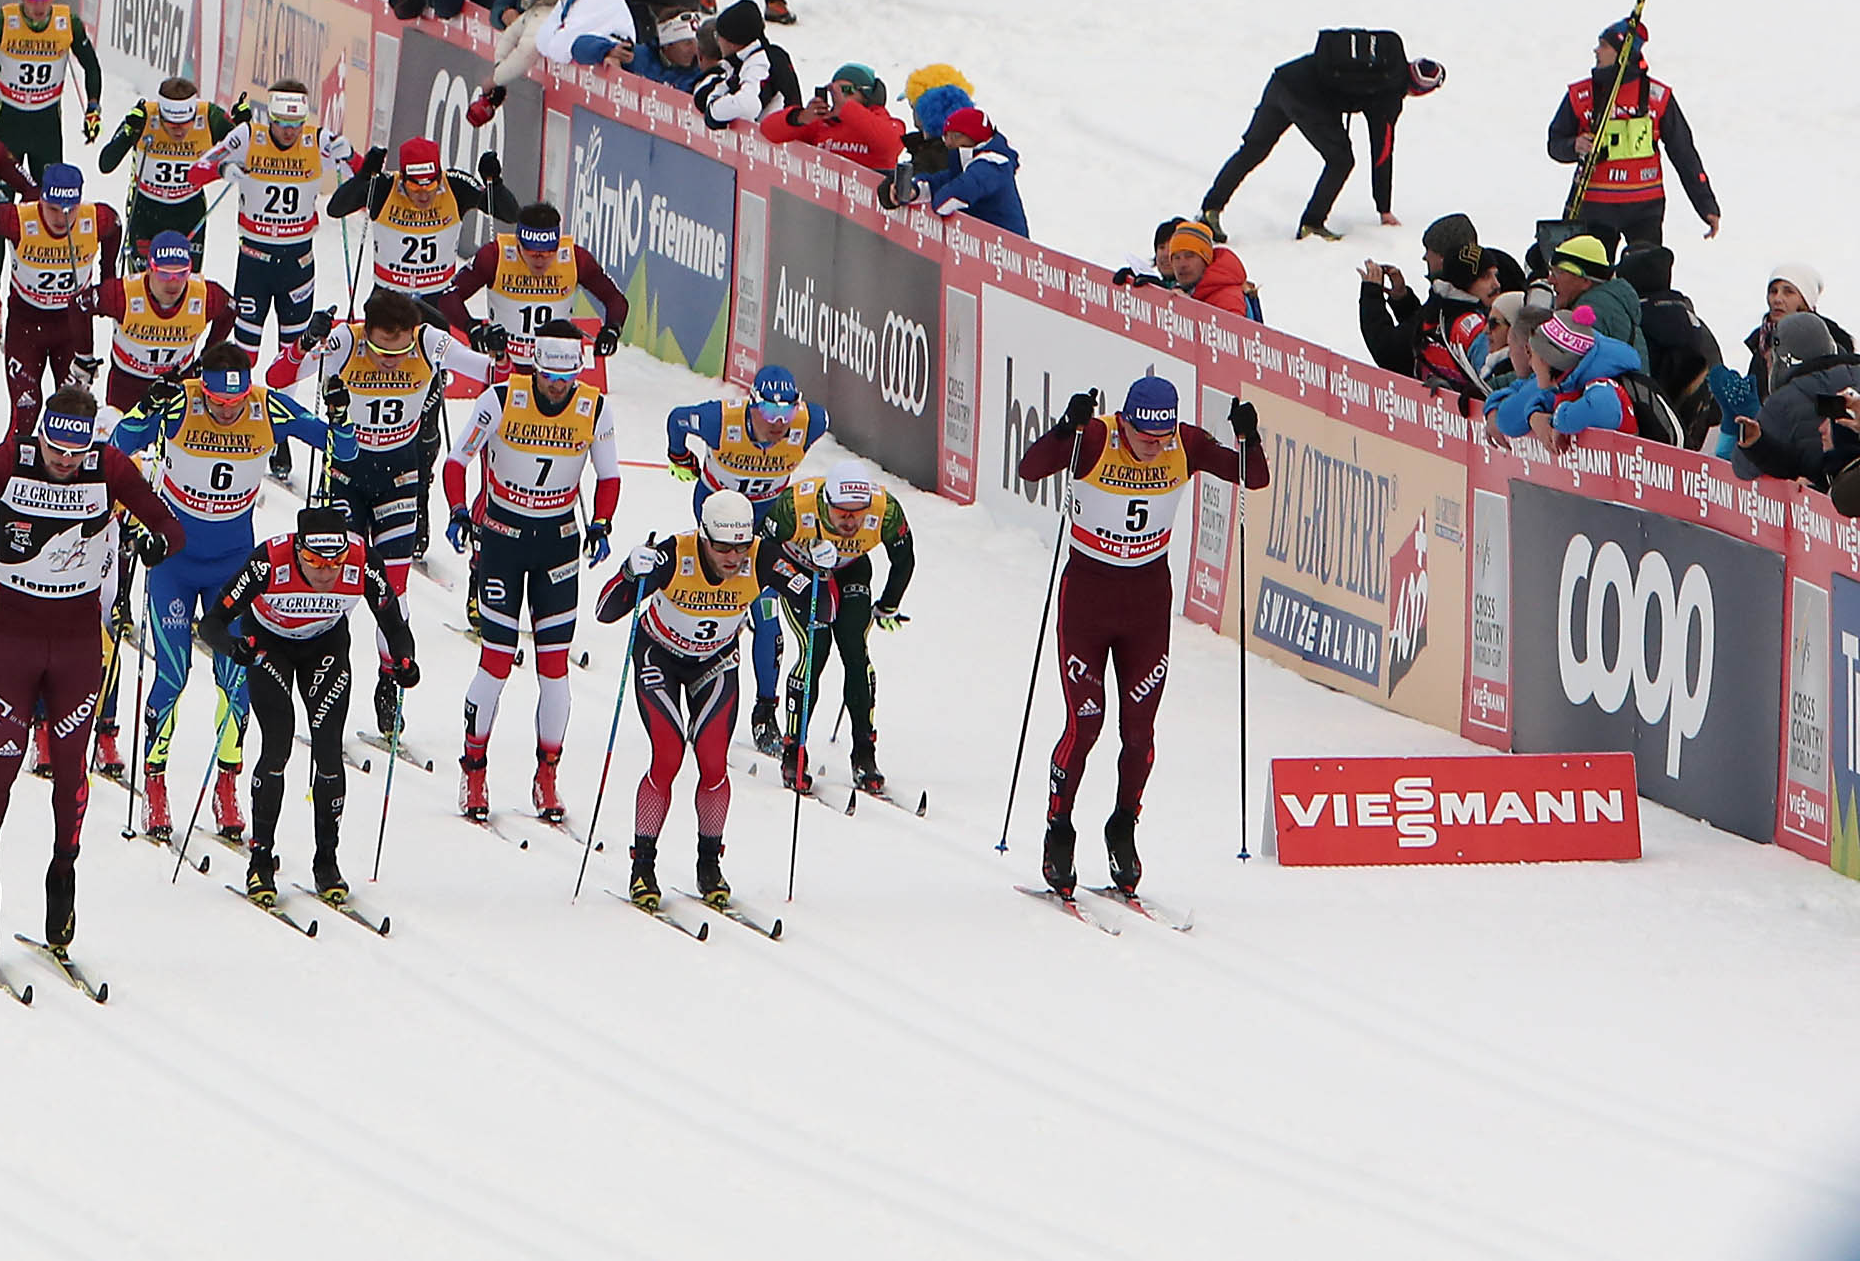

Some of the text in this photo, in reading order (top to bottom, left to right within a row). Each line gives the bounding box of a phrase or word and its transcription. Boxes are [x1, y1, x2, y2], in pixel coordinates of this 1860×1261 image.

[19, 63, 52, 84] 39
[155, 162, 188, 183] 35
[805, 155, 840, 199] VIESSMANN
[1608, 168, 1627, 182] FIN
[264, 185, 299, 214] 29
[841, 170, 874, 214] VIESSMANN
[255, 224, 304, 235] VIESSMANN
[521, 229, 557, 243] LUKOIL
[648, 194, 727, 281] fiemme
[946, 219, 980, 265] VIESSMANN
[401, 236, 438, 264] 25
[985, 236, 1022, 282] VIESSMANN
[38, 271, 76, 289] 23
[392, 273, 445, 287] VIESSMANN
[1025, 251, 1066, 299] VIESSMANN
[1068, 268, 1108, 314] VIESSMANN
[519, 305, 552, 333] 19
[773, 265, 815, 347] Audi
[817, 299, 876, 383] quattro
[1112, 284, 1151, 331] VIESSMANN
[1155, 299, 1195, 348] VIESSMANN
[1198, 314, 1238, 363] VIESSMANN
[1243, 331, 1283, 380] VIESSMANN
[1286, 346, 1327, 397] VIESSMANN
[1330, 364, 1370, 415] VIESSMANN
[1374, 381, 1418, 431] VIESSMANN
[48, 416, 92, 434] LUKOIL
[365, 398, 405, 425] 13
[1135, 407, 1177, 421] LUKOIL
[1423, 397, 1468, 448] VIESSMANN
[186, 430, 204, 444] LE
[506, 422, 523, 437] LE
[210, 461, 234, 490] 6
[535, 457, 554, 486] 7
[1101, 463, 1167, 481] LE GRUYÈRE
[1557, 435, 1612, 488] VIESSMANN
[1616, 445, 1674, 500] VIESSMANN
[13, 483, 85, 505] LE GRUYÈRE
[184, 496, 248, 514] VIESSMANN
[507, 491, 565, 508] VIESSMANN
[1074, 499, 1081, 514] 5
[1265, 433, 1296, 563] LE
[1681, 462, 1733, 519] VIESSMANN
[1126, 498, 1149, 531] 5
[1738, 480, 1785, 536] VIESSMANN
[1790, 495, 1831, 552] VIESSMANN
[1099, 539, 1161, 558] VIESSMANN
[10, 574, 86, 594] fiemme
[231, 571, 251, 602] BKW
[673, 590, 693, 602] LE
[269, 595, 341, 608] LE GRUYÈRE
[1475, 592, 1496, 620] CROSS
[693, 620, 718, 639] 3
[1259, 587, 1379, 674] SWITZERLAND
[1474, 619, 1504, 645] COUNTRY
[1557, 533, 1715, 780] coop
[308, 654, 335, 698] odlo
[1129, 652, 1171, 704] LUKOIL
[54, 691, 99, 741] LUKOIL
[311, 669, 350, 730] RAIFFEISEN
[788, 697, 797, 712] 9
[1472, 682, 1506, 720] VIESSMANN
[1793, 691, 1816, 721] CROSS
[1792, 717, 1823, 750] COUNTRY
[1280, 776, 1624, 848] VIESSMANN
[1789, 789, 1825, 828] VIESSMANN
